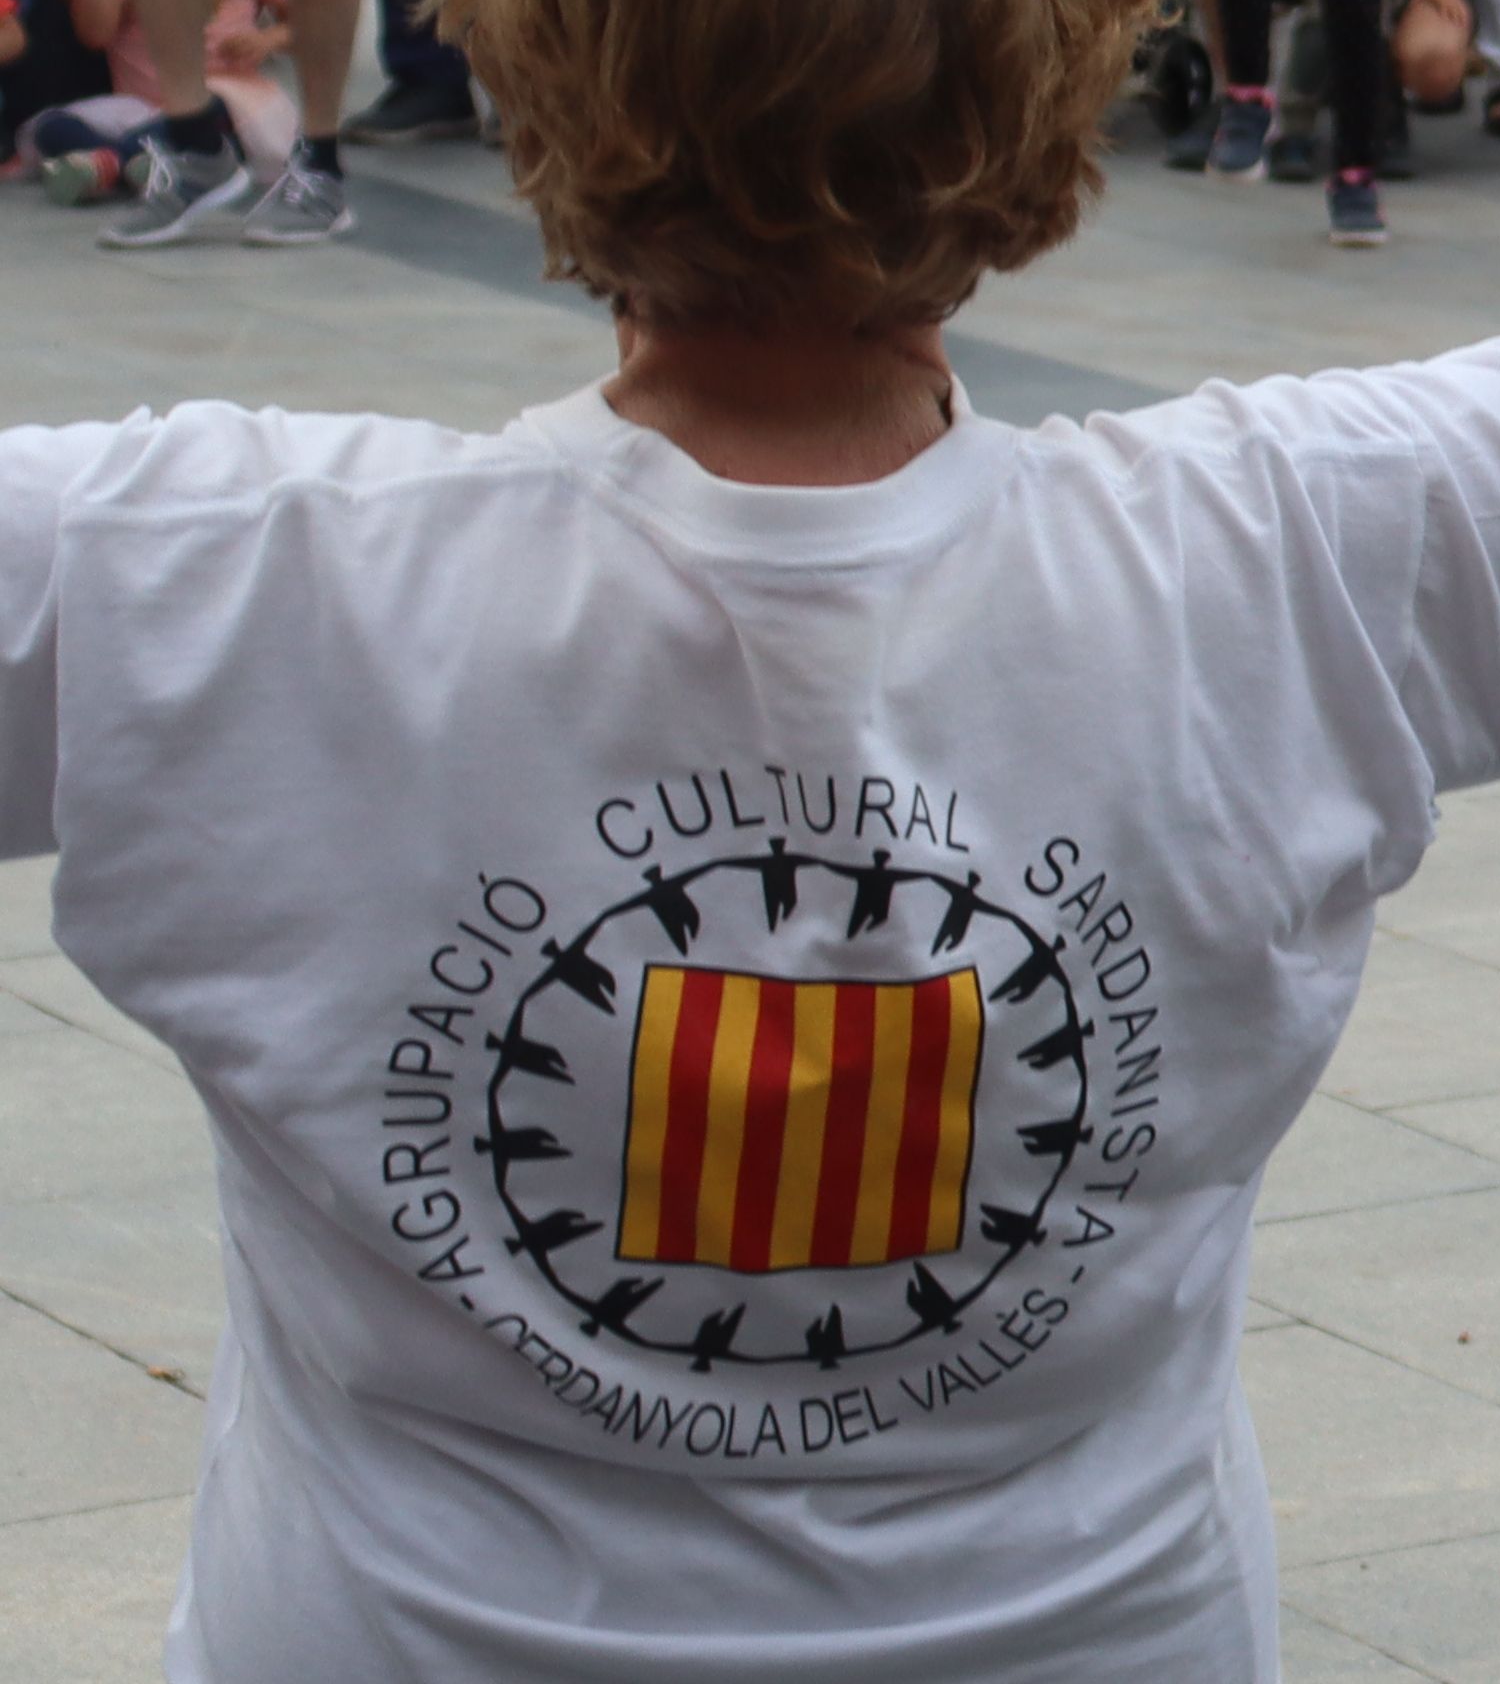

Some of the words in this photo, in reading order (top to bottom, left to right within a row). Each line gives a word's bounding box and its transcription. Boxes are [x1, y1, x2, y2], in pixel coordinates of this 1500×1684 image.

[381, 873, 547, 1283] AGRUPACIÓ
[596, 765, 970, 860] CULTURAL
[1024, 836, 1163, 1250] SARDANISTA
[802, 1388, 898, 1454] DEL
[900, 1287, 1070, 1413] VALLÈS
